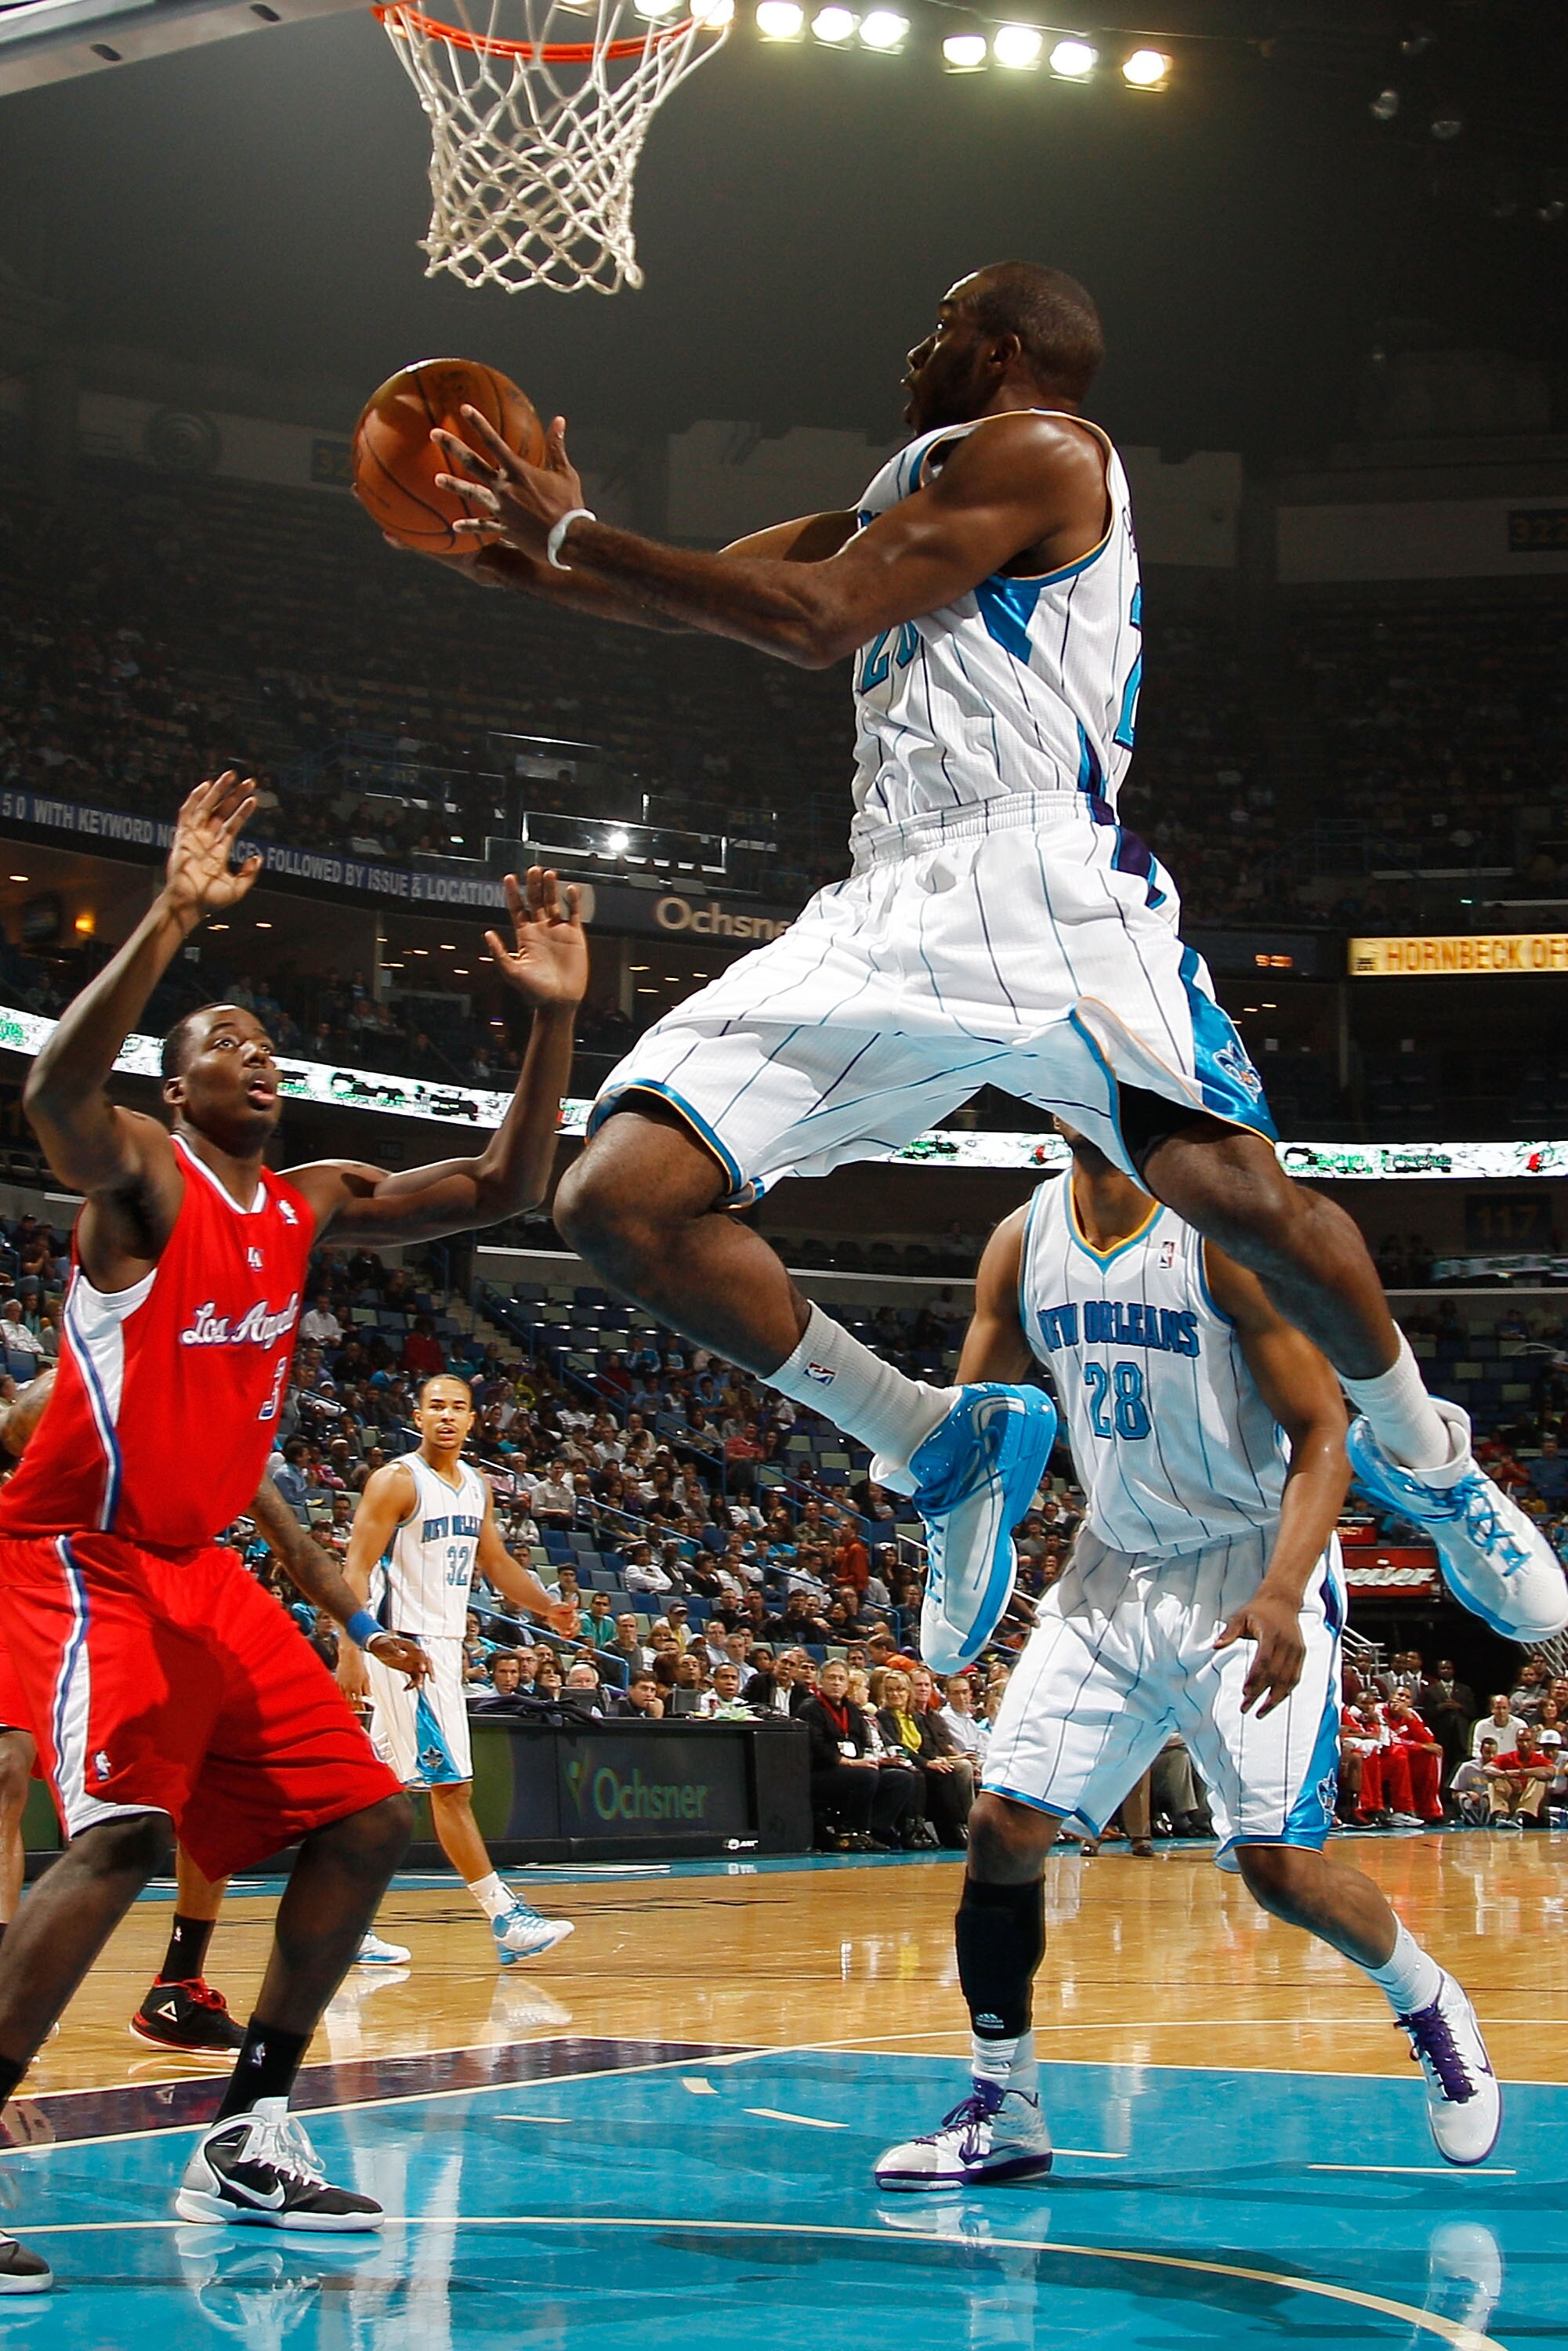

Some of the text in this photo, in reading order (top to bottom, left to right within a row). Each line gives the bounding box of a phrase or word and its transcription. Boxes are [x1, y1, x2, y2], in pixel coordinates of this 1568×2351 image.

[34, 799, 74, 829] WITH
[79, 806, 154, 844] KEYWORD
[266, 846, 342, 886] FOLLOWED
[345, 864, 364, 889] BY
[368, 868, 408, 897] ISSUE
[411, 875, 422, 898] &
[427, 877, 506, 907] LOCATION
[654, 897, 791, 940] Ochsne
[1388, 939, 1523, 971] HORNBECK
[1531, 938, 1568, 969] OF
[179, 1299, 232, 1347] Los
[1083, 1300, 1200, 1359] ORLEANS
[1084, 1361, 1152, 1440] 28
[447, 1545, 469, 1585] 32
[593, 1767, 708, 1820] Ochsner
